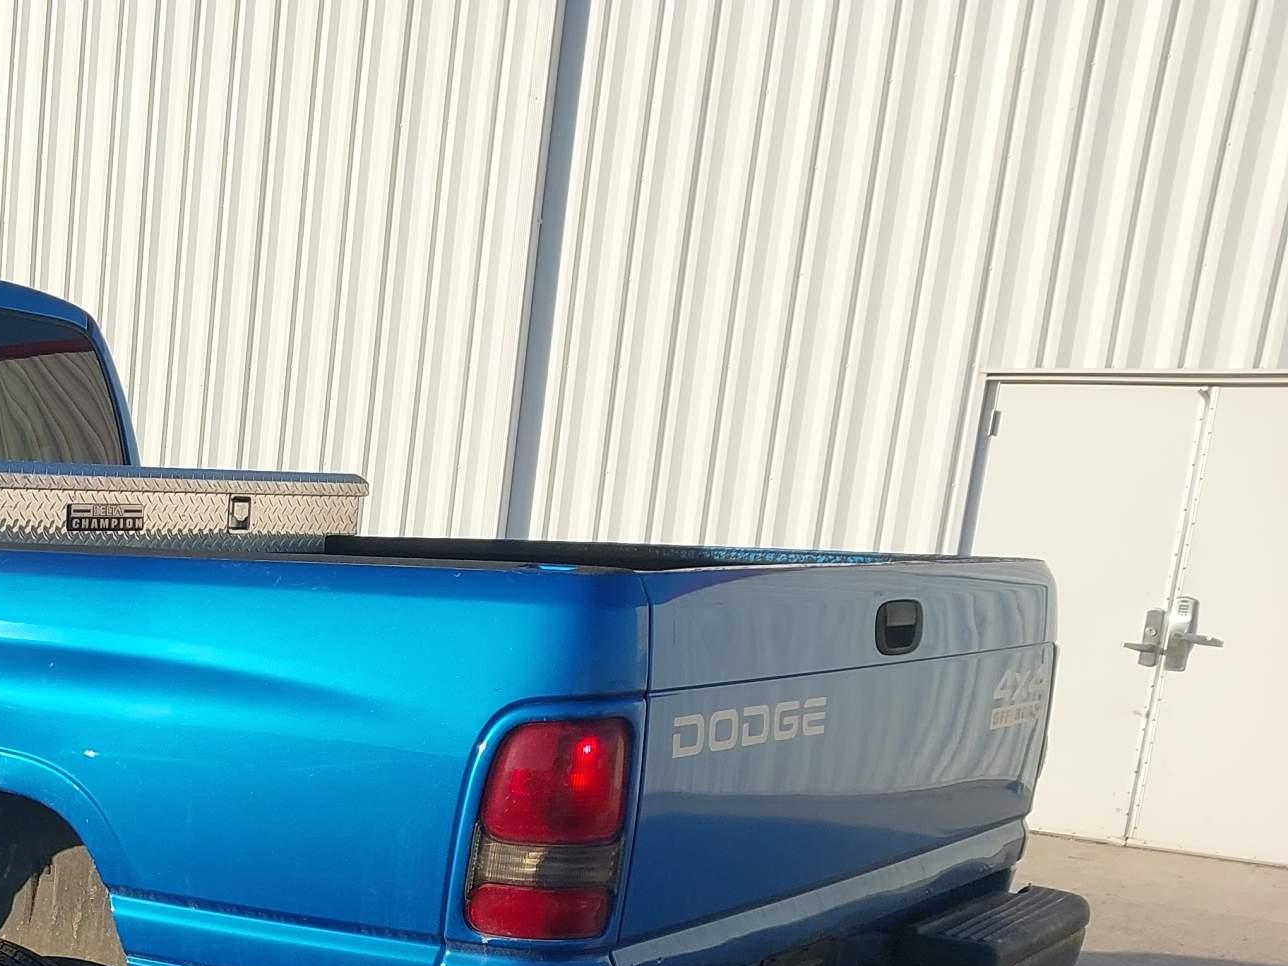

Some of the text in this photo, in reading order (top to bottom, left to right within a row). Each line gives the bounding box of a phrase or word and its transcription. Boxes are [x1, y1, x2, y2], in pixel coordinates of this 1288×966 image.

[93, 505, 123, 516] DELTA
[72, 518, 143, 529] CHAMPION
[672, 697, 827, 758] DODGE
